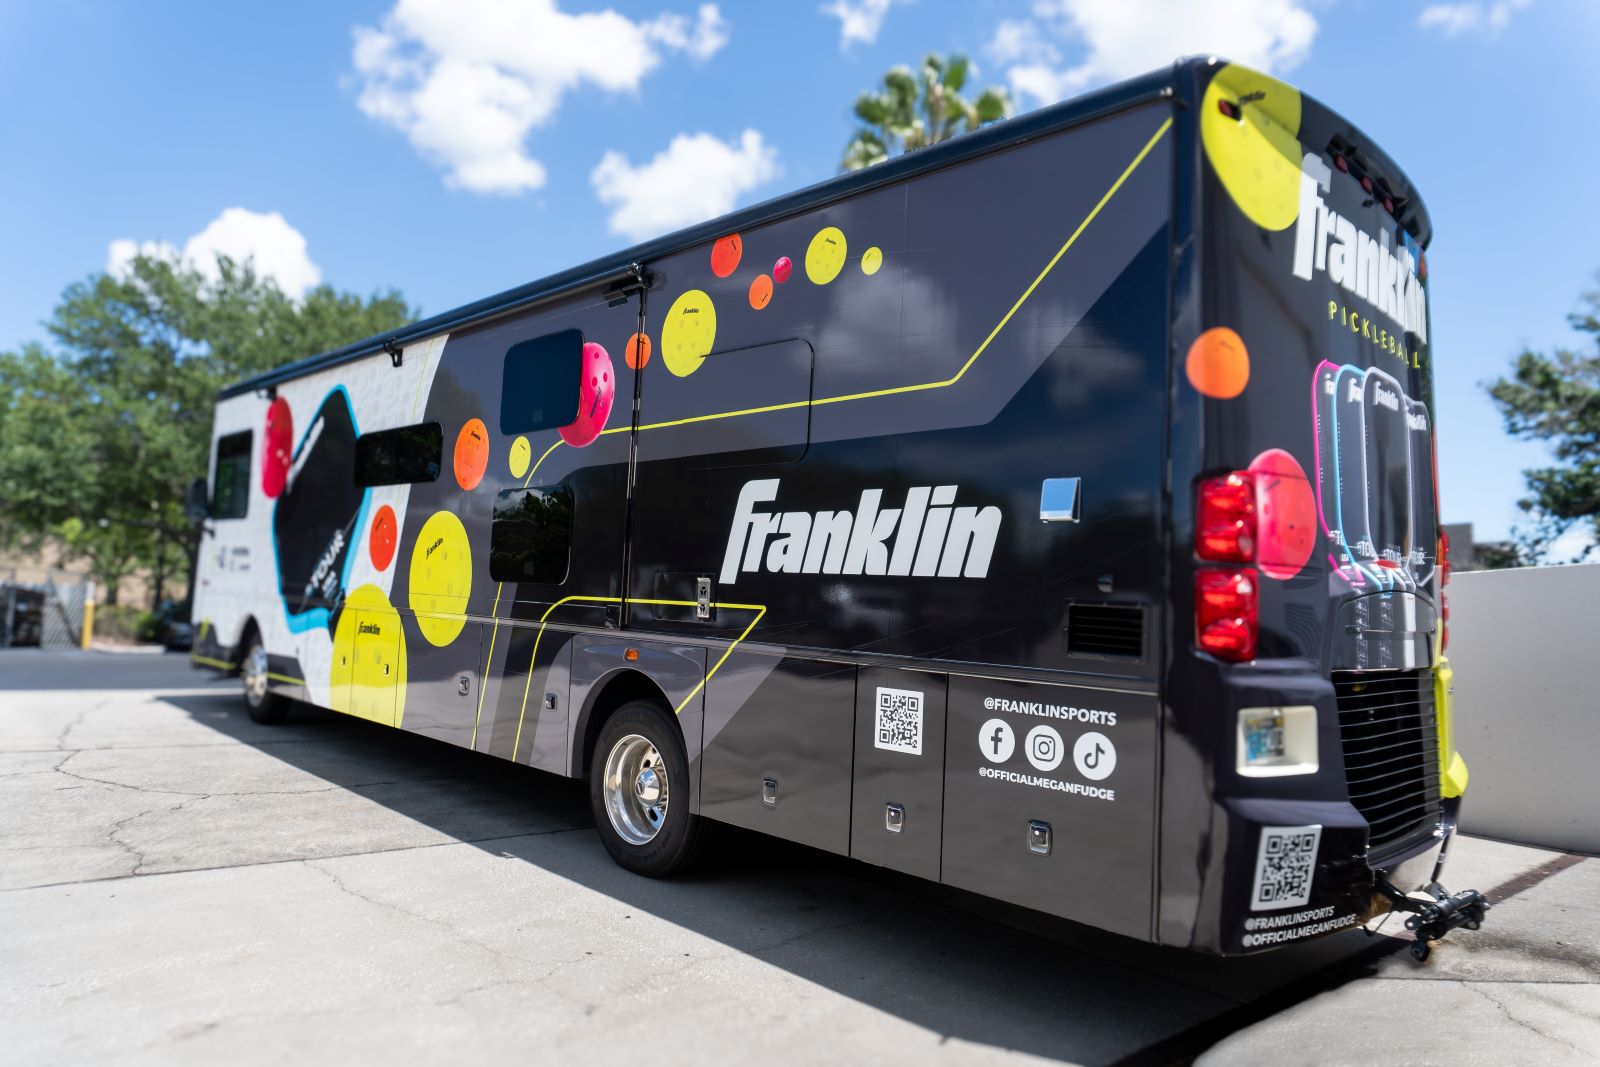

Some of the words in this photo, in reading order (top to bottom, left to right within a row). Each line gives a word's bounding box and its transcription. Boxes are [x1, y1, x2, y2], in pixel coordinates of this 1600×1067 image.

[1328, 300, 1421, 369] PICKLEBALL
[984, 697, 1117, 726] @FRANKLINSPORTS
[979, 767, 1115, 801] @OFFICIALMEGANFUDGE
[1242, 914, 1357, 947] @OFFICIALMEGANFUDGE
[1244, 905, 1335, 931] @FRANKLINSPORTS
